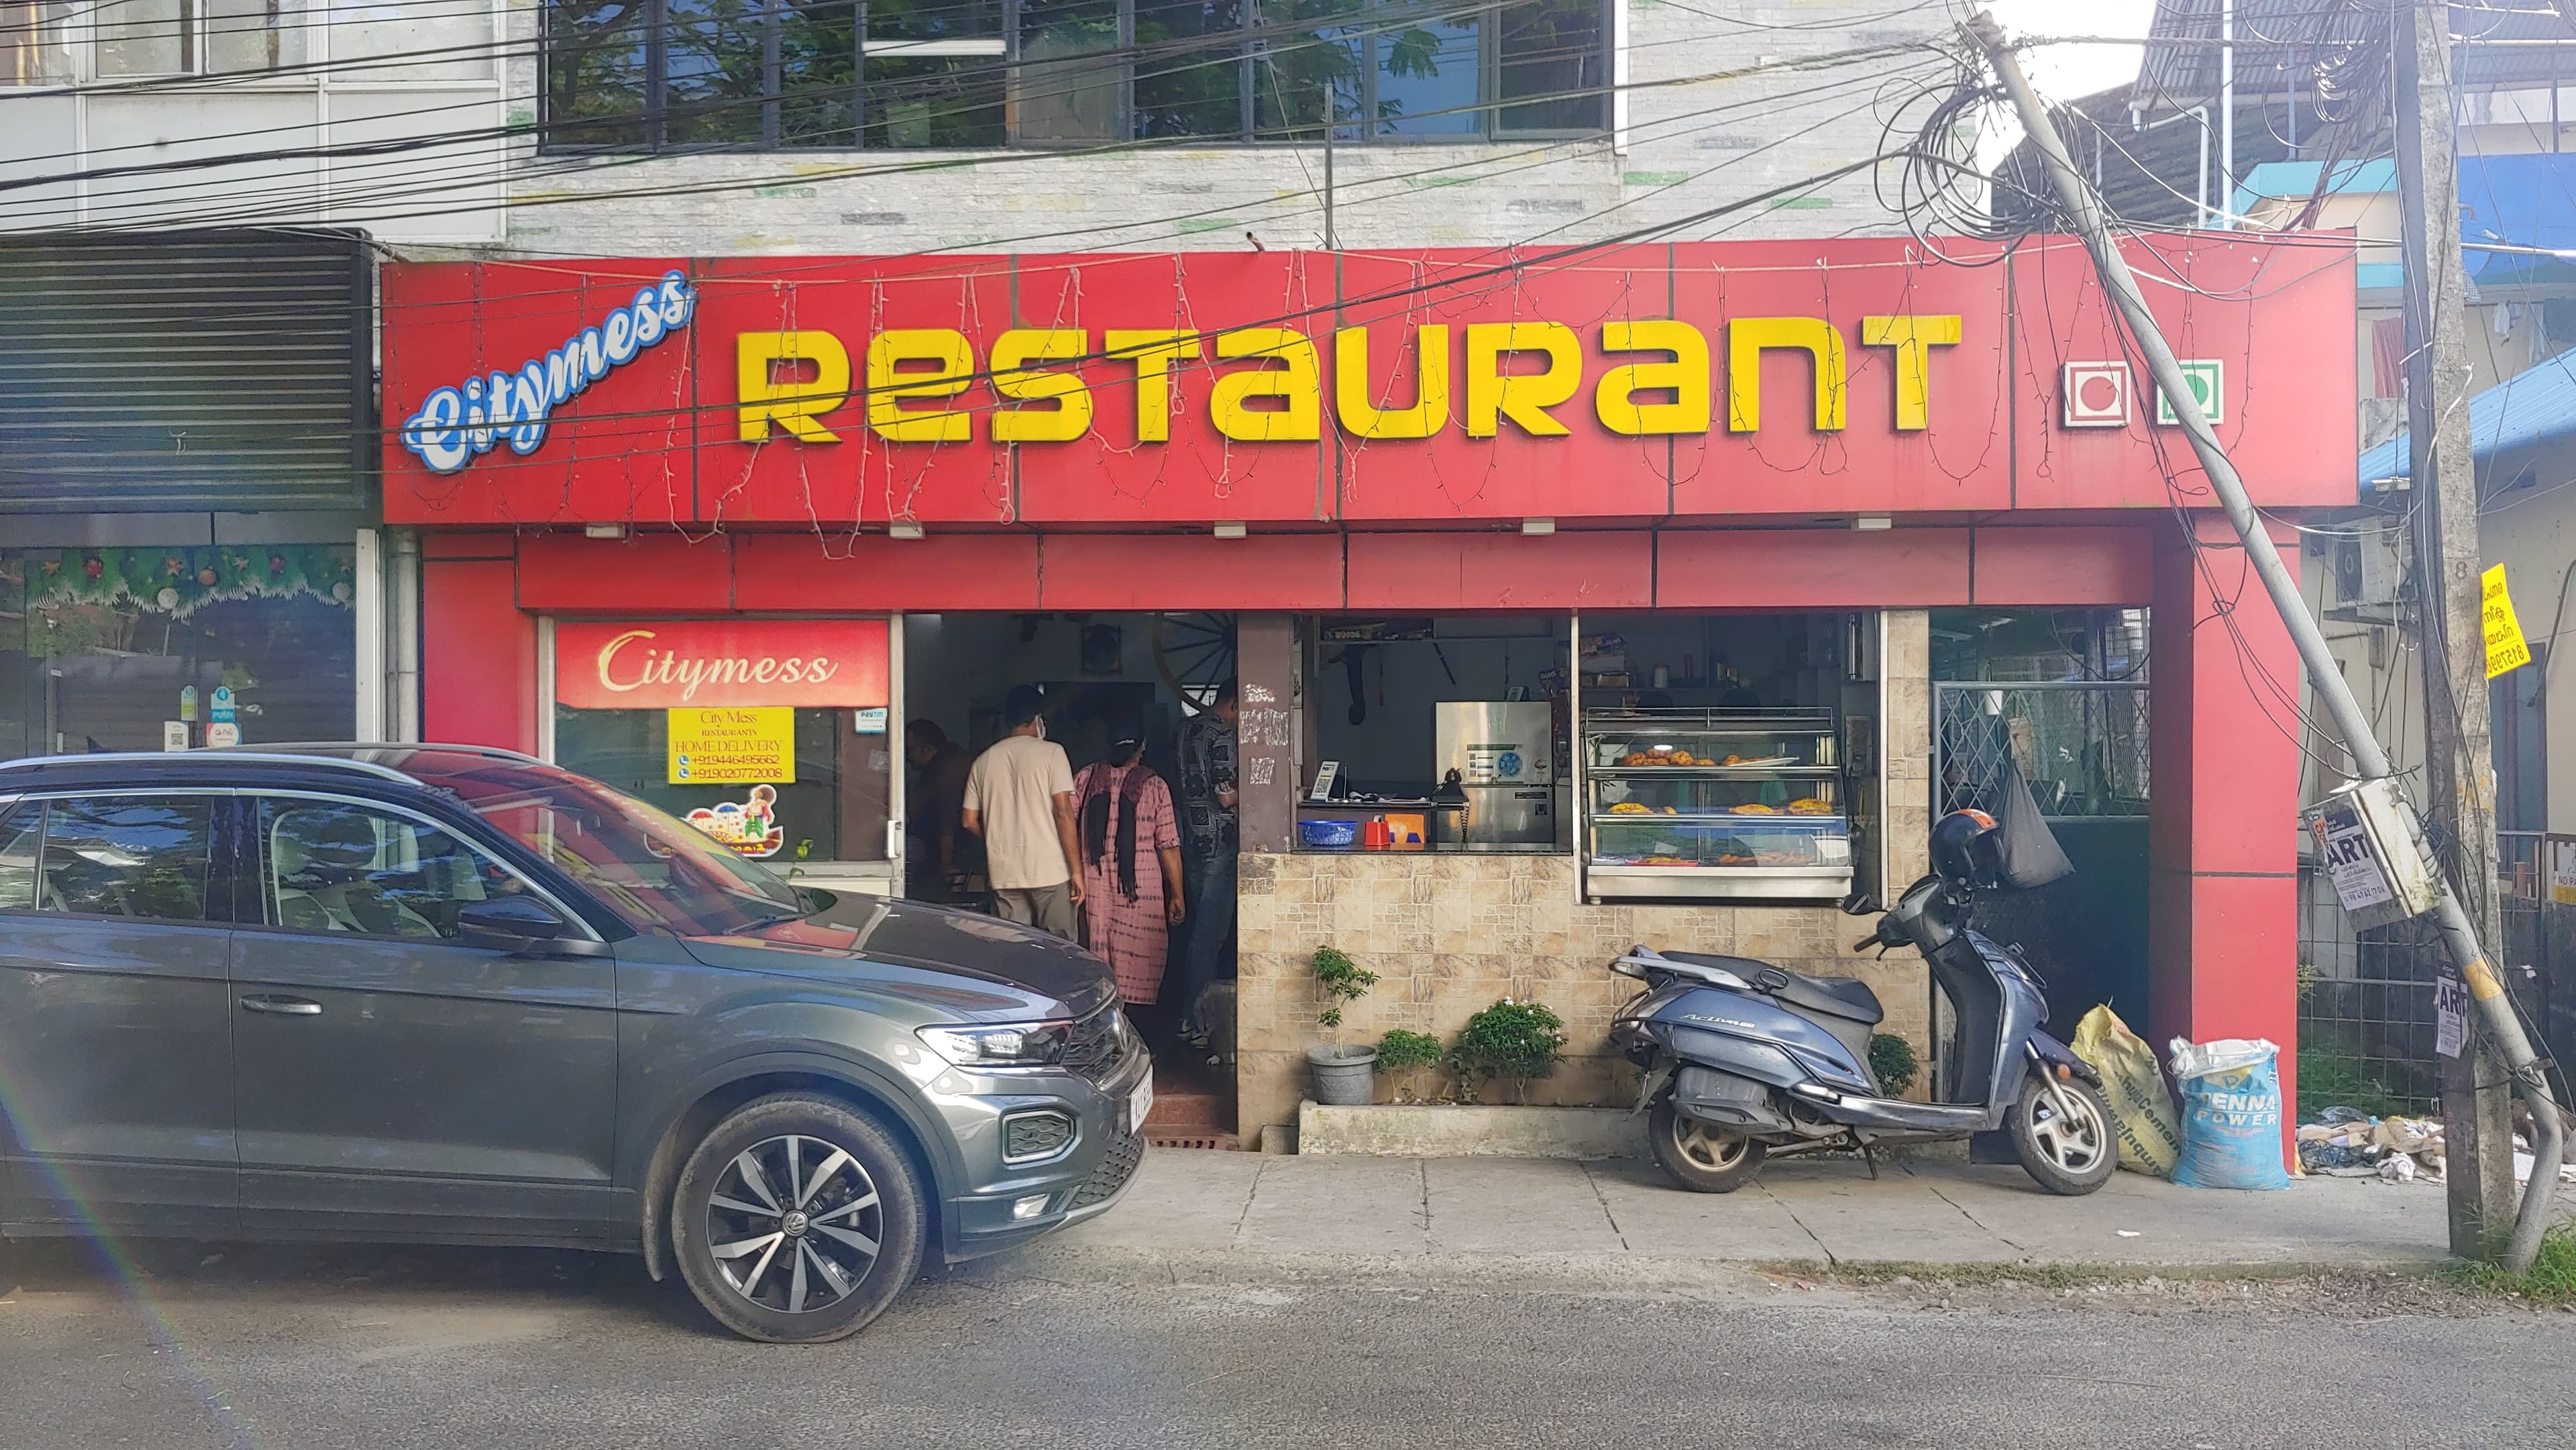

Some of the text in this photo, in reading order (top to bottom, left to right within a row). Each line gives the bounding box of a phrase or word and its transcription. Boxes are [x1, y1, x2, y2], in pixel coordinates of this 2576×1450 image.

[402, 270, 696, 473] Citymess
[598, 629, 839, 701] Citymess
[700, 710, 757, 725] City Mess
[676, 739, 783, 752] HOME DELIVERY
[692, 754, 780, 766] +919446495662
[692, 768, 784, 779] +919020772008
[2326, 833, 2369, 868] ART
[2559, 875, 2567, 885] NO
[2196, 1110, 2277, 1126] POWER
